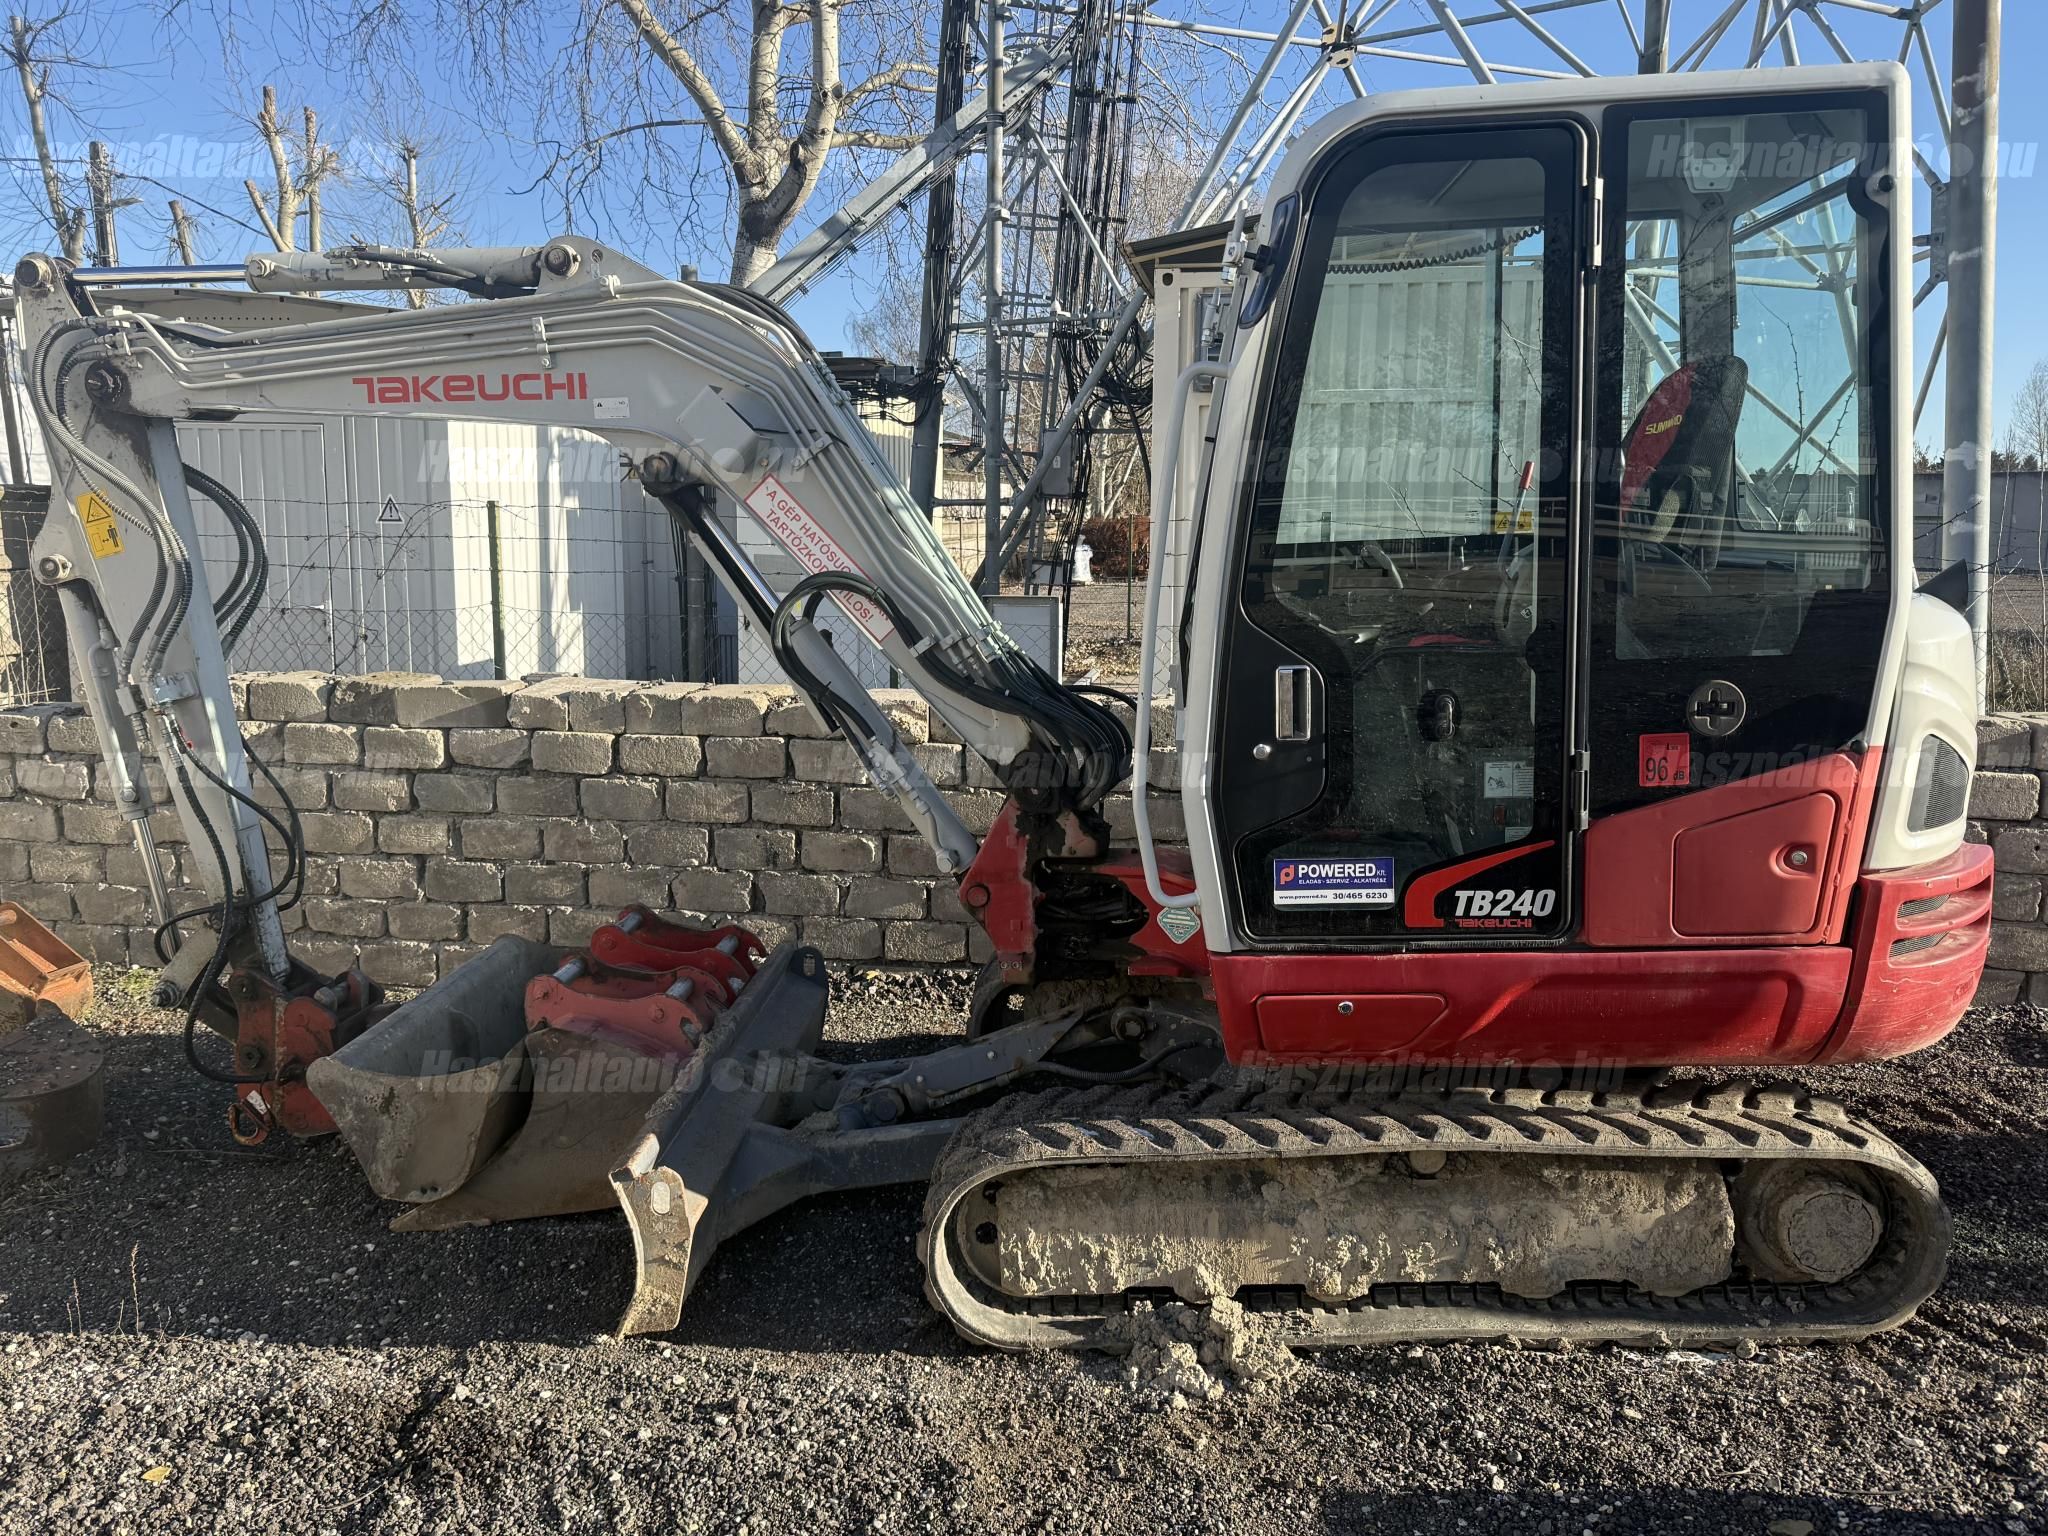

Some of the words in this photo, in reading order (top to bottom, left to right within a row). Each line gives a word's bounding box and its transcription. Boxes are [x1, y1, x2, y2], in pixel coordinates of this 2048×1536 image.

[352, 372, 588, 404] TAKEUCHI
[766, 490, 778, 501] A
[777, 499, 802, 522] GÉP
[839, 590, 874, 622] ILOS!
[1645, 756, 1668, 781] 96
[1298, 863, 1376, 878] POWERED
[1332, 892, 1363, 900] 30/465
[1455, 889, 1556, 917] TB240
[1455, 918, 1533, 928] TAKEUCHI
